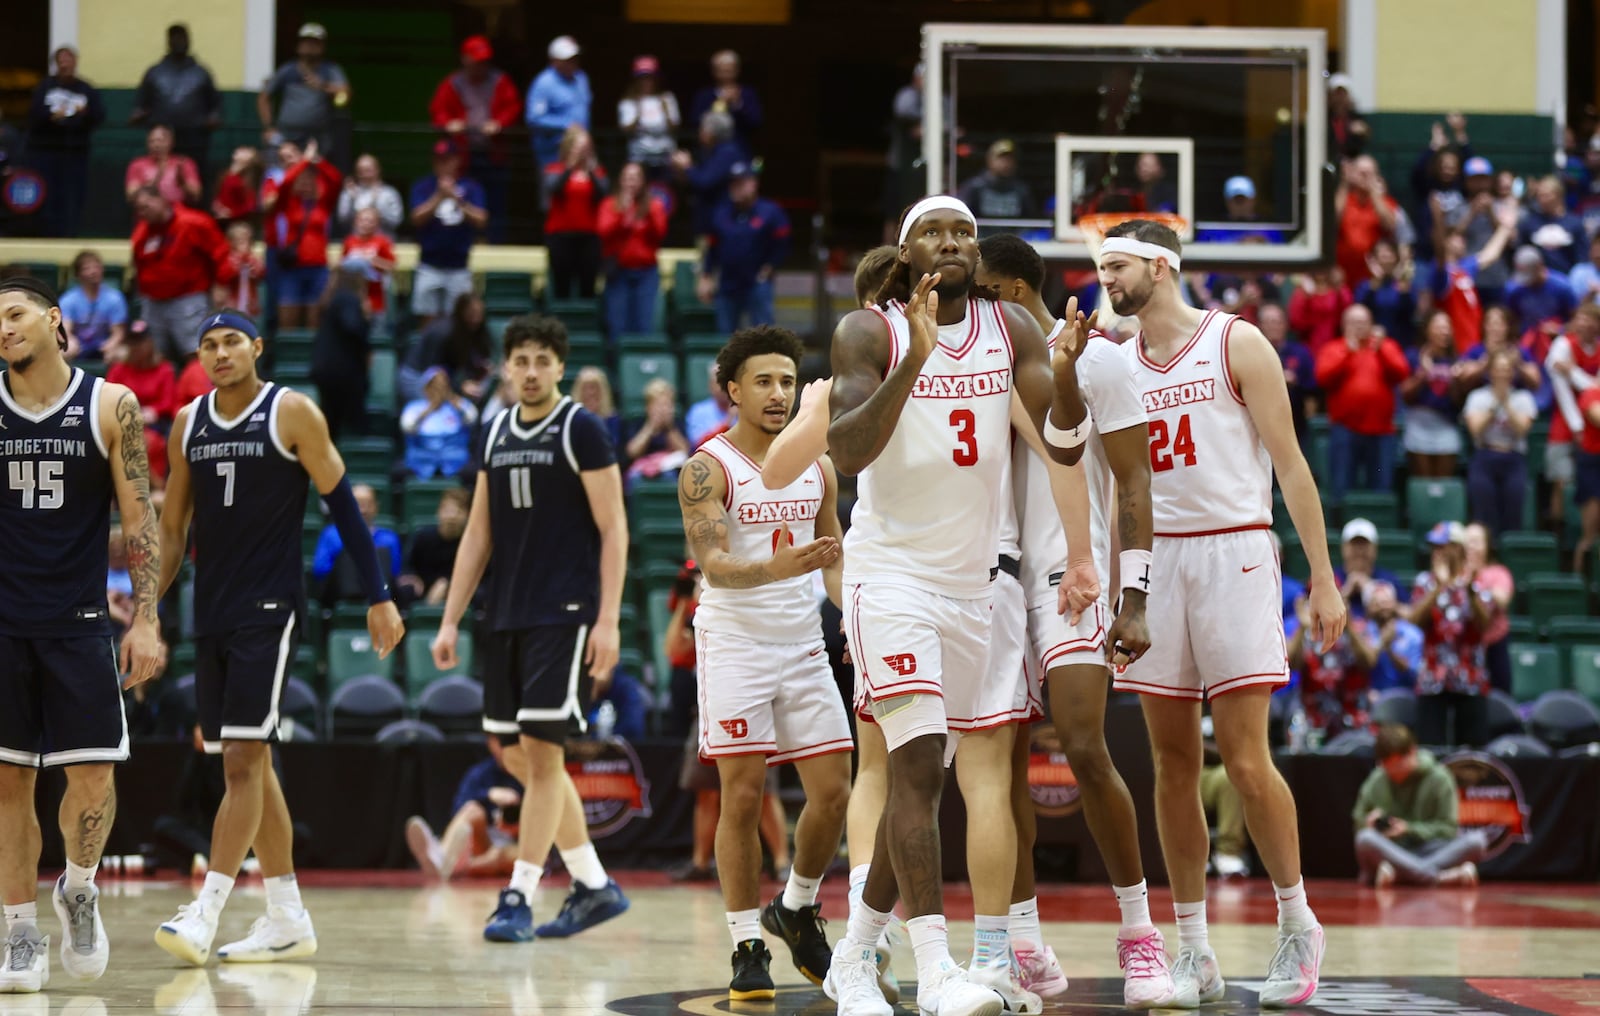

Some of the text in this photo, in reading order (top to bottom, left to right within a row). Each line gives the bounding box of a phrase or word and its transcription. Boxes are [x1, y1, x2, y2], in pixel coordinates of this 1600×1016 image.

[911, 368, 1009, 398] DAYTON
[1142, 378, 1214, 413] AYTON
[0, 438, 86, 457] EORGETOWN
[190, 442, 264, 462] GEORGETOWN
[949, 409, 978, 467] 3
[1148, 414, 1197, 472] 24
[8, 461, 64, 509] 45
[216, 462, 235, 506] 7
[510, 467, 532, 508] 11
[738, 499, 820, 524] DAYTON
